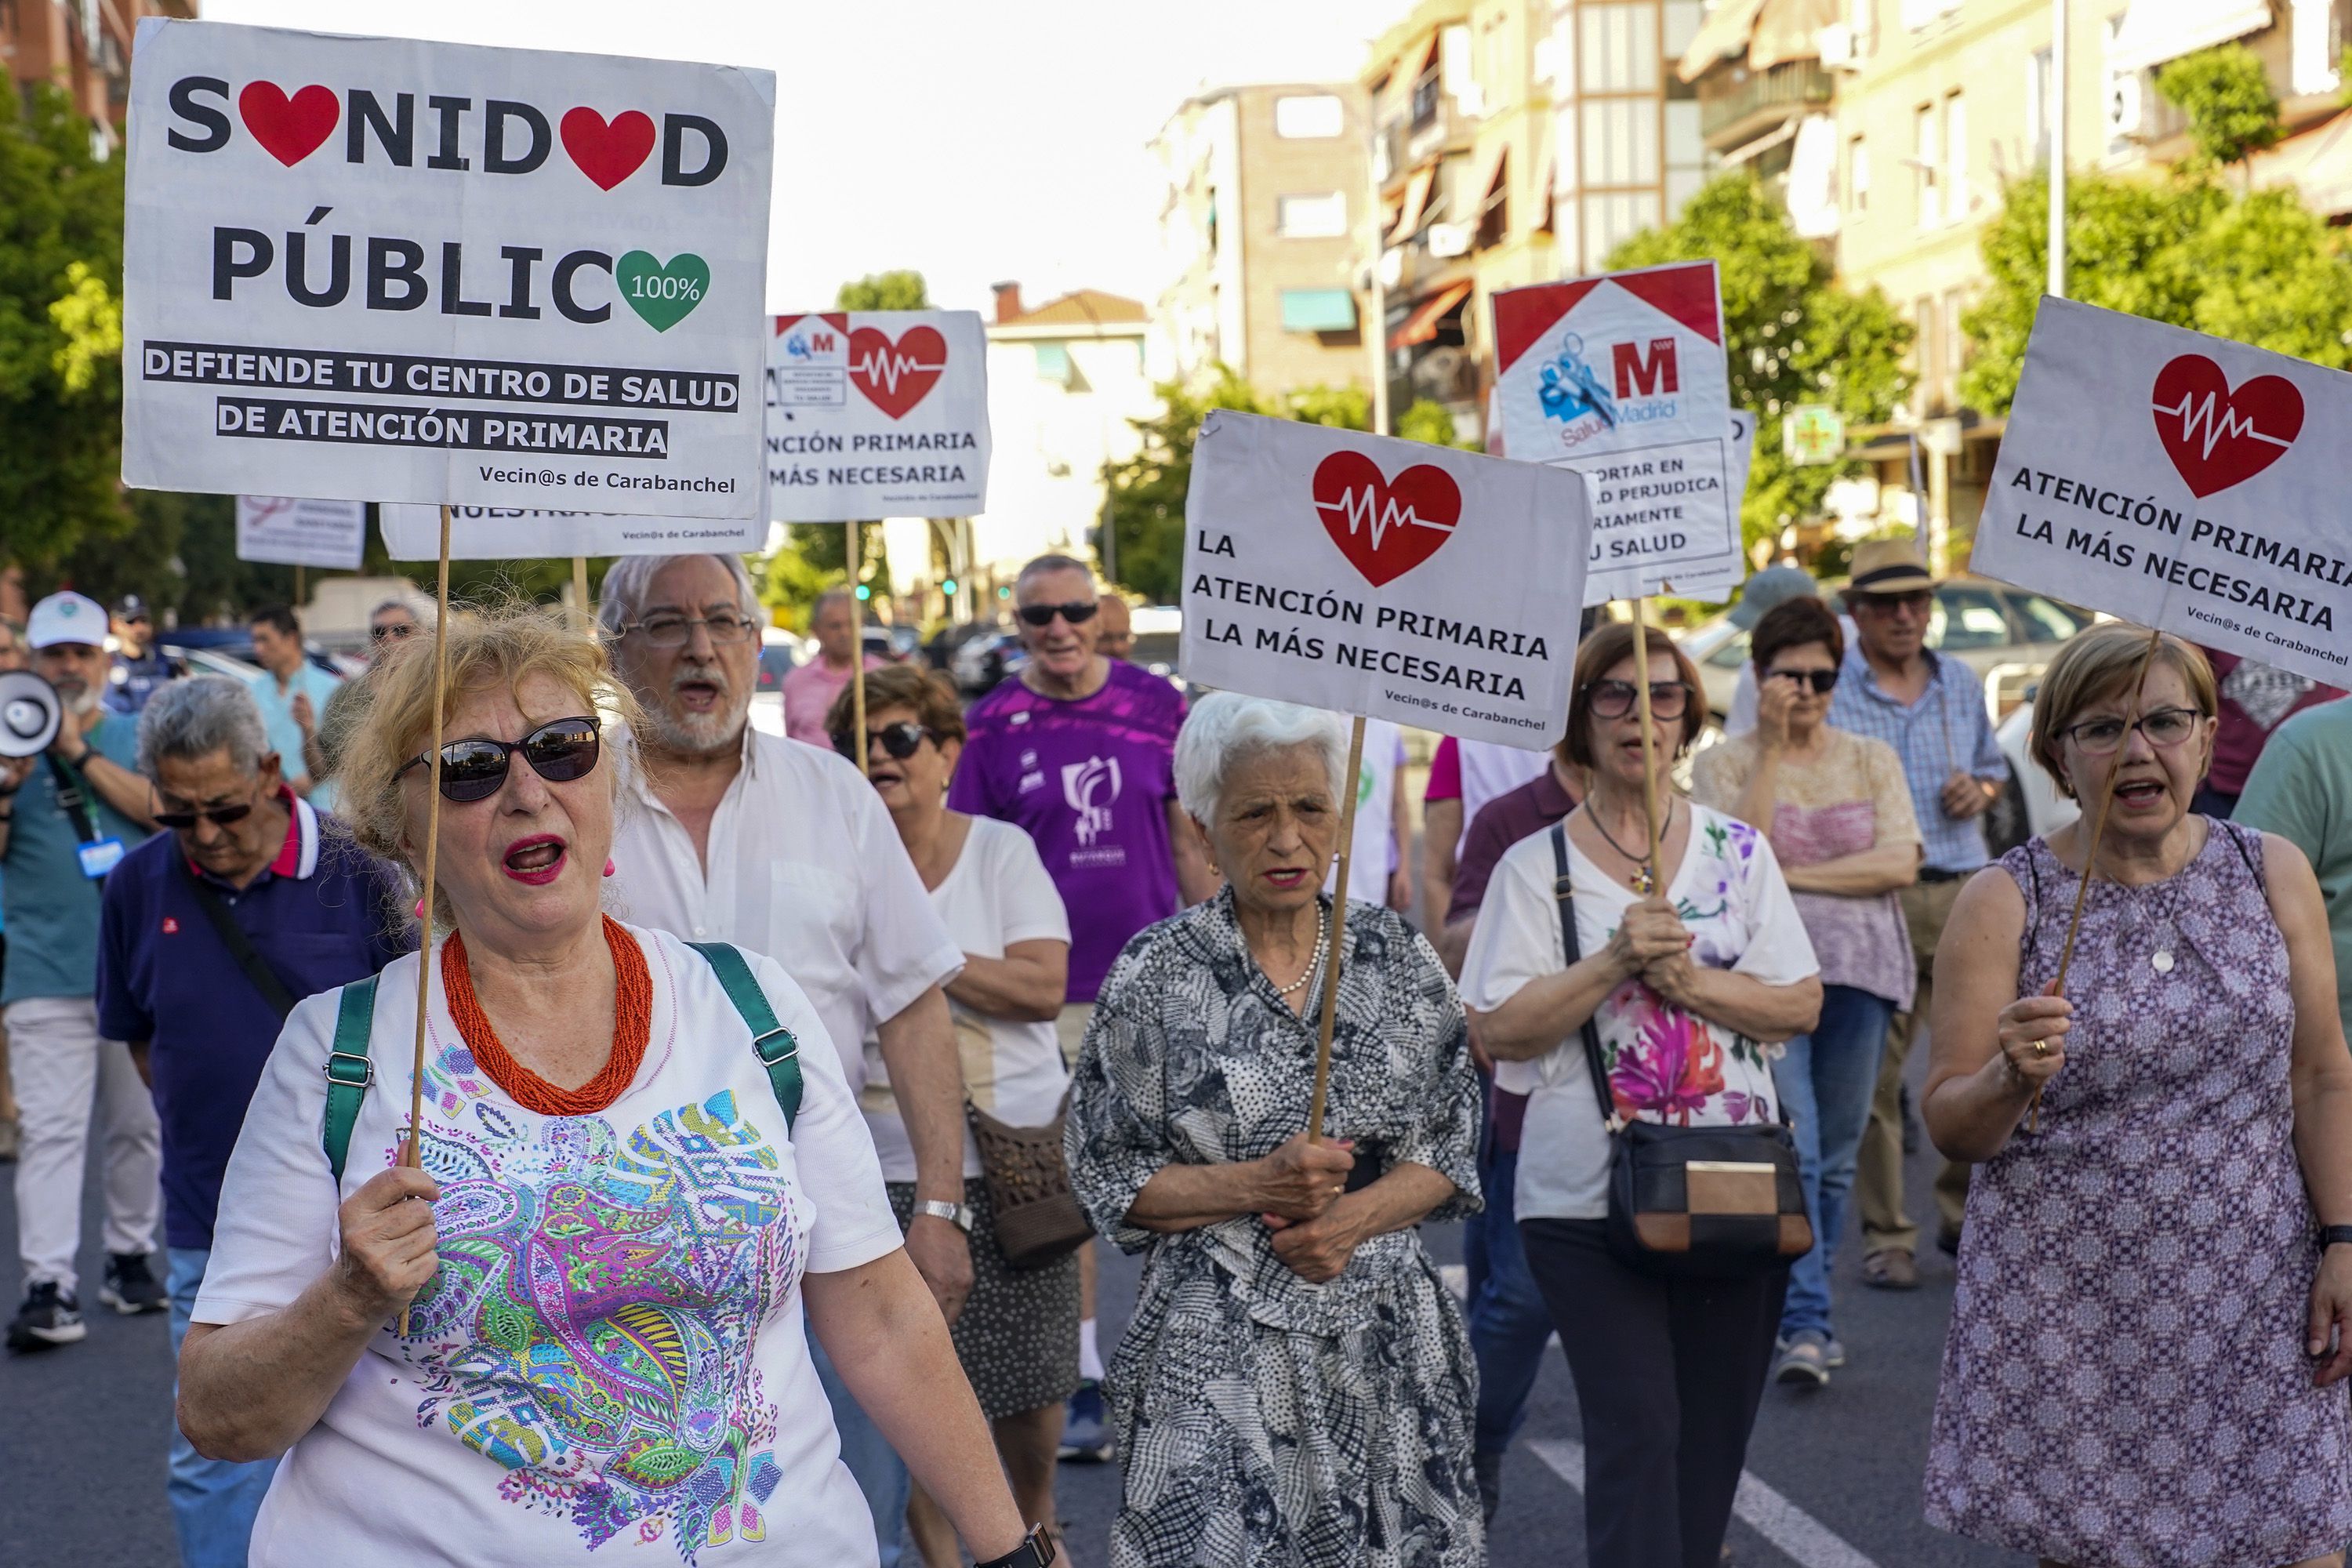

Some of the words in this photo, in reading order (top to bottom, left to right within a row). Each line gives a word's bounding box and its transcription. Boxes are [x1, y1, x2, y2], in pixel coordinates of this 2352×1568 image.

[630, 274, 700, 303] 100%
[145, 349, 334, 386] DEFIENDE
[345, 360, 393, 389] TU
[406, 364, 551, 398] CENTRO
[564, 373, 609, 401] DE
[621, 376, 738, 408] SALUD
[1612, 401, 1675, 423] Madrid
[220, 405, 266, 434] DE
[278, 407, 472, 445] ATENCIÓN
[483, 420, 667, 454] PRIMARIA
[853, 431, 976, 452] PRIMARIA
[1561, 418, 1613, 448] Salu
[479, 466, 567, 487] Vecin@s
[573, 470, 599, 488] de
[605, 473, 735, 493] Carabanchel
[769, 464, 818, 485] MÁS
[828, 465, 965, 484] NECESARIA
[1660, 459, 1683, 474] EN
[1619, 477, 1719, 503] PERJUDICA
[2011, 466, 2183, 535] ATENCIÓN
[667, 530, 679, 539] de
[682, 528, 745, 538] Carabanchel
[1198, 530, 1236, 559] LA
[1610, 532, 1686, 558] SALUD
[2016, 513, 2054, 545] LA
[2065, 530, 2136, 568] MÁS
[2143, 552, 2333, 632] NECESARIA
[1191, 574, 1363, 625] ATENCIÓN
[1375, 607, 1549, 661] PRIMARIA
[2187, 606, 2241, 632] Vecin@s
[2243, 625, 2262, 639] de
[2264, 632, 2350, 666] Carabanchel
[1204, 619, 1243, 647] LA
[1254, 628, 1325, 660] MÁS
[1335, 643, 1526, 701] NECESARIA
[1385, 689, 1439, 710] Vecin@s
[1441, 701, 1459, 715] de
[1461, 706, 1547, 731] Carabanchel
